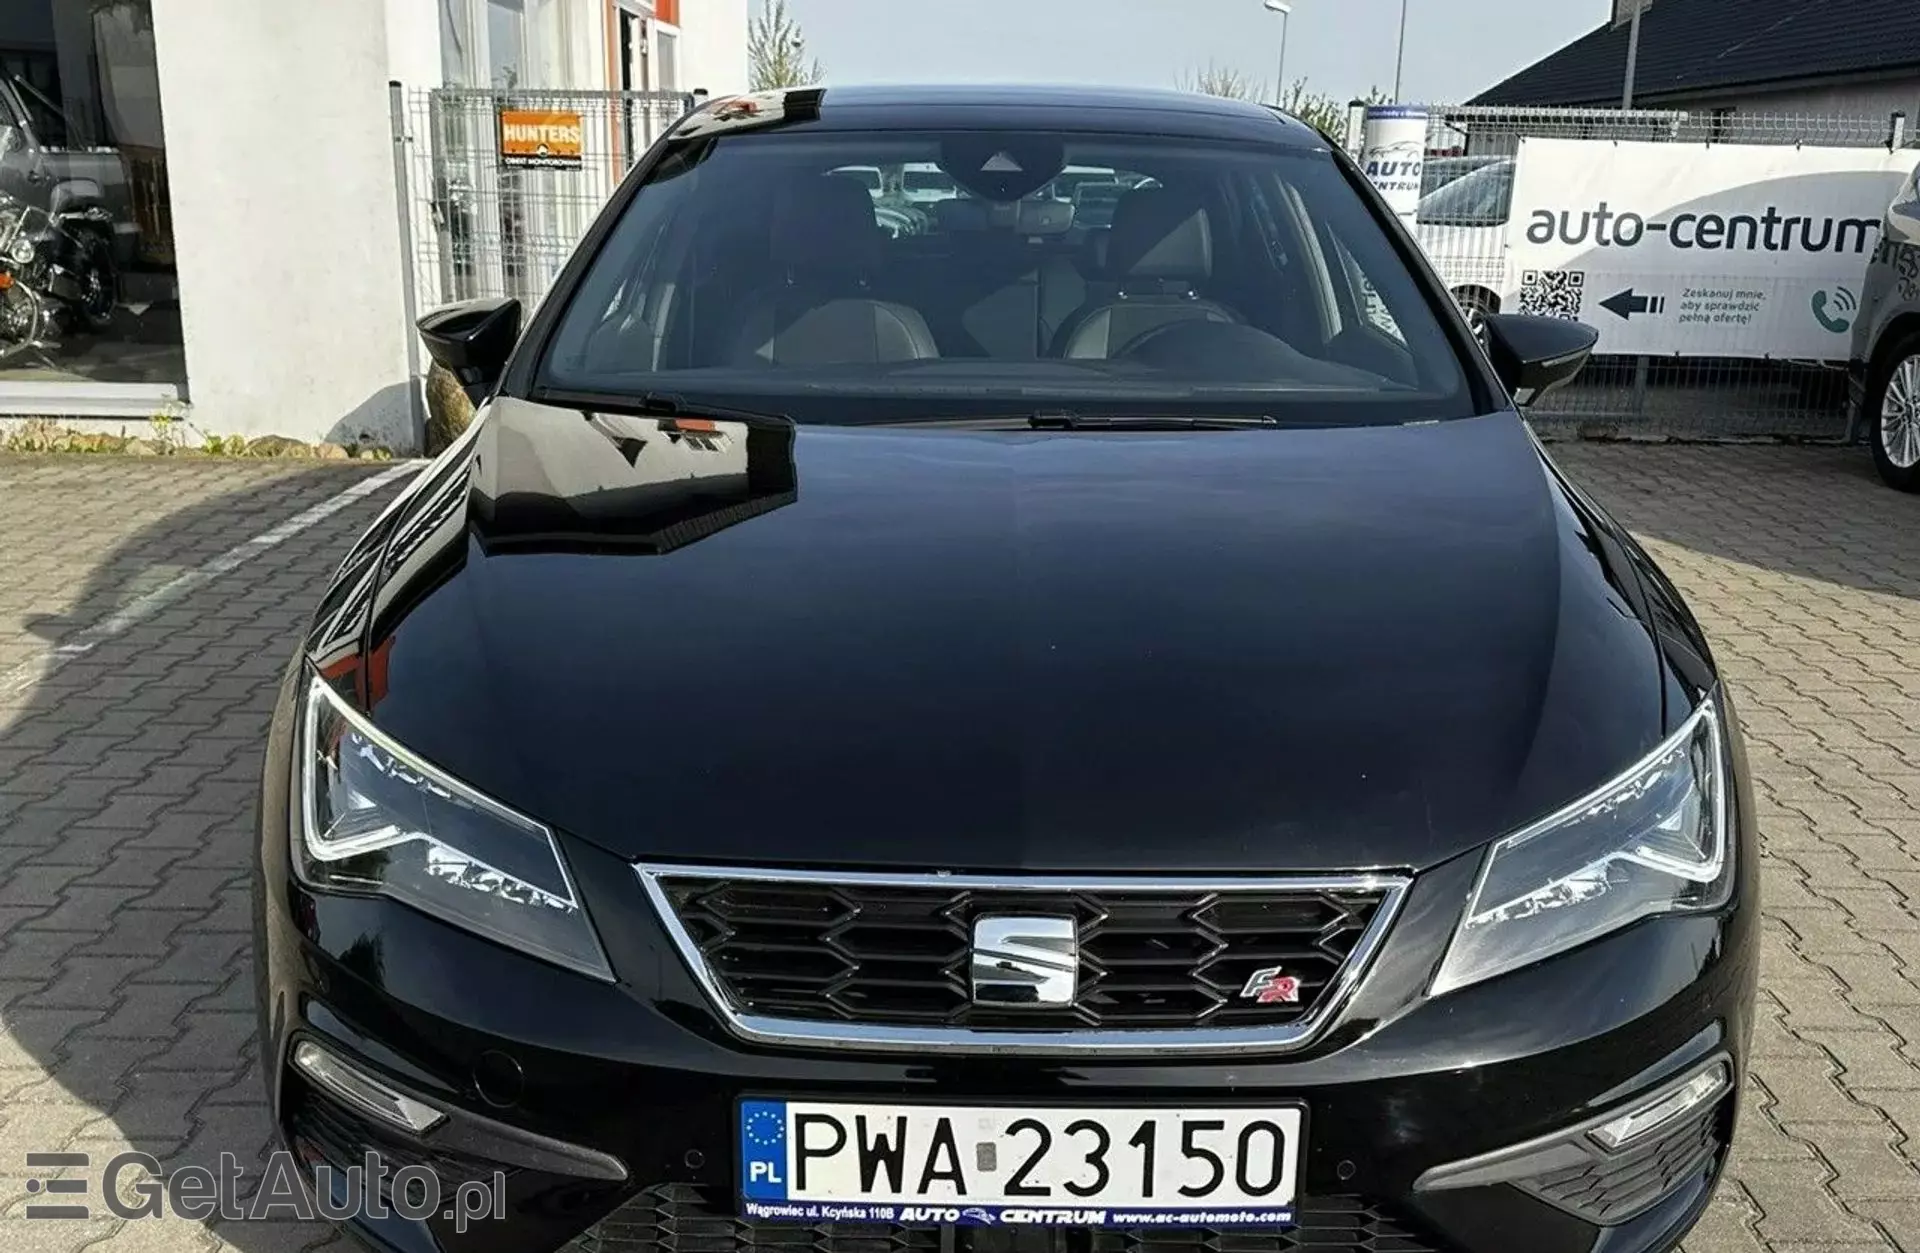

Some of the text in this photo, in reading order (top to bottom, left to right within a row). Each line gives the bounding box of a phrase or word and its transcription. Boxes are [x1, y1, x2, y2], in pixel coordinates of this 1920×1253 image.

[503, 124, 580, 144] HUNTERS
[1366, 161, 1421, 176] AUTO
[1526, 201, 1882, 253] auto-centrum
[1682, 287, 1766, 301] Zeskanuj mnie,
[1680, 301, 1760, 312] aby sprawdzić
[1679, 312, 1752, 325] pełną ofertę!
[1240, 966, 1300, 1003] FR
[794, 1112, 1286, 1198] PWA 23150
[749, 1160, 782, 1184] PL
[746, 1202, 1291, 1224] Wągrowiec ul. Kcyńska 110B AUTO CENTRUM www.ac-automoto.com
